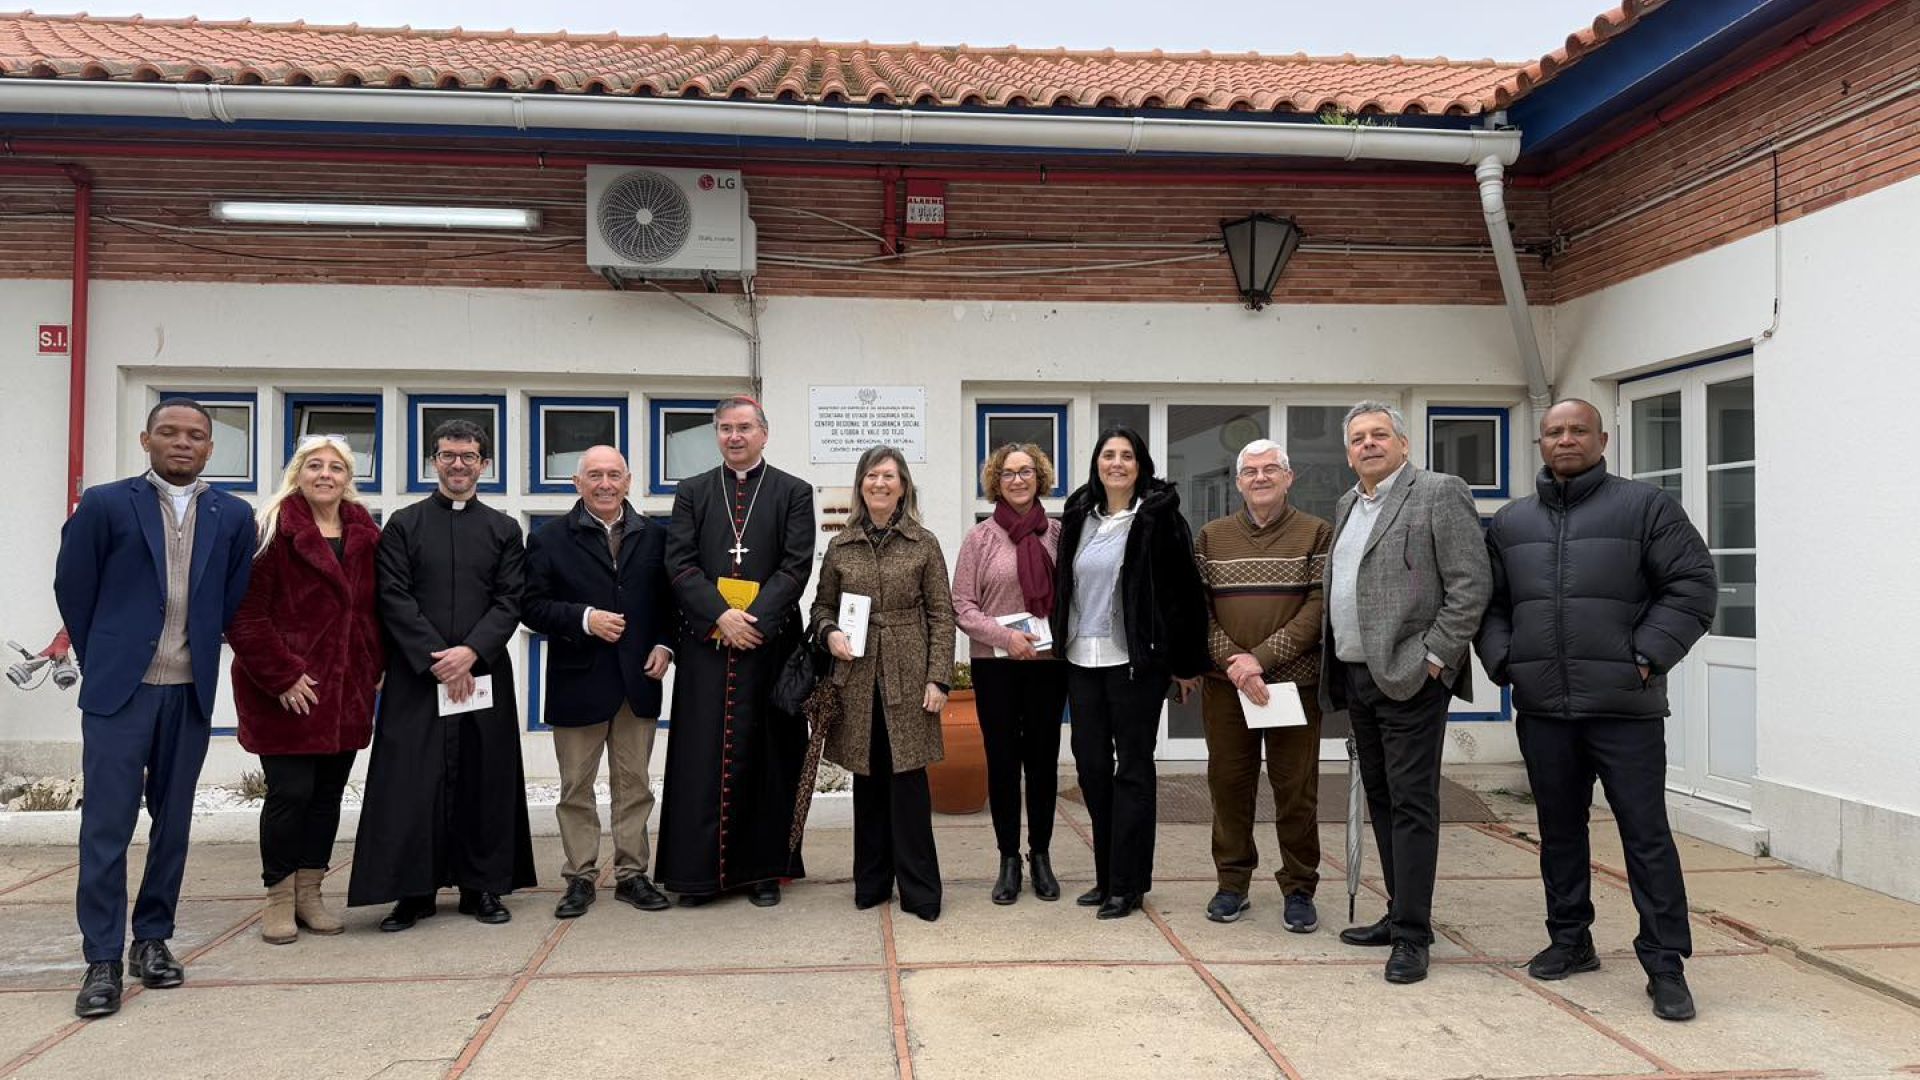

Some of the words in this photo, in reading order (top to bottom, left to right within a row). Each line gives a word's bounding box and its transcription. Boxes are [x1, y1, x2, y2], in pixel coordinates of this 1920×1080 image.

[718, 177, 736, 189] LG
[40, 331, 67, 347] S.I.
[871, 420, 900, 428] SEGURANÇA
